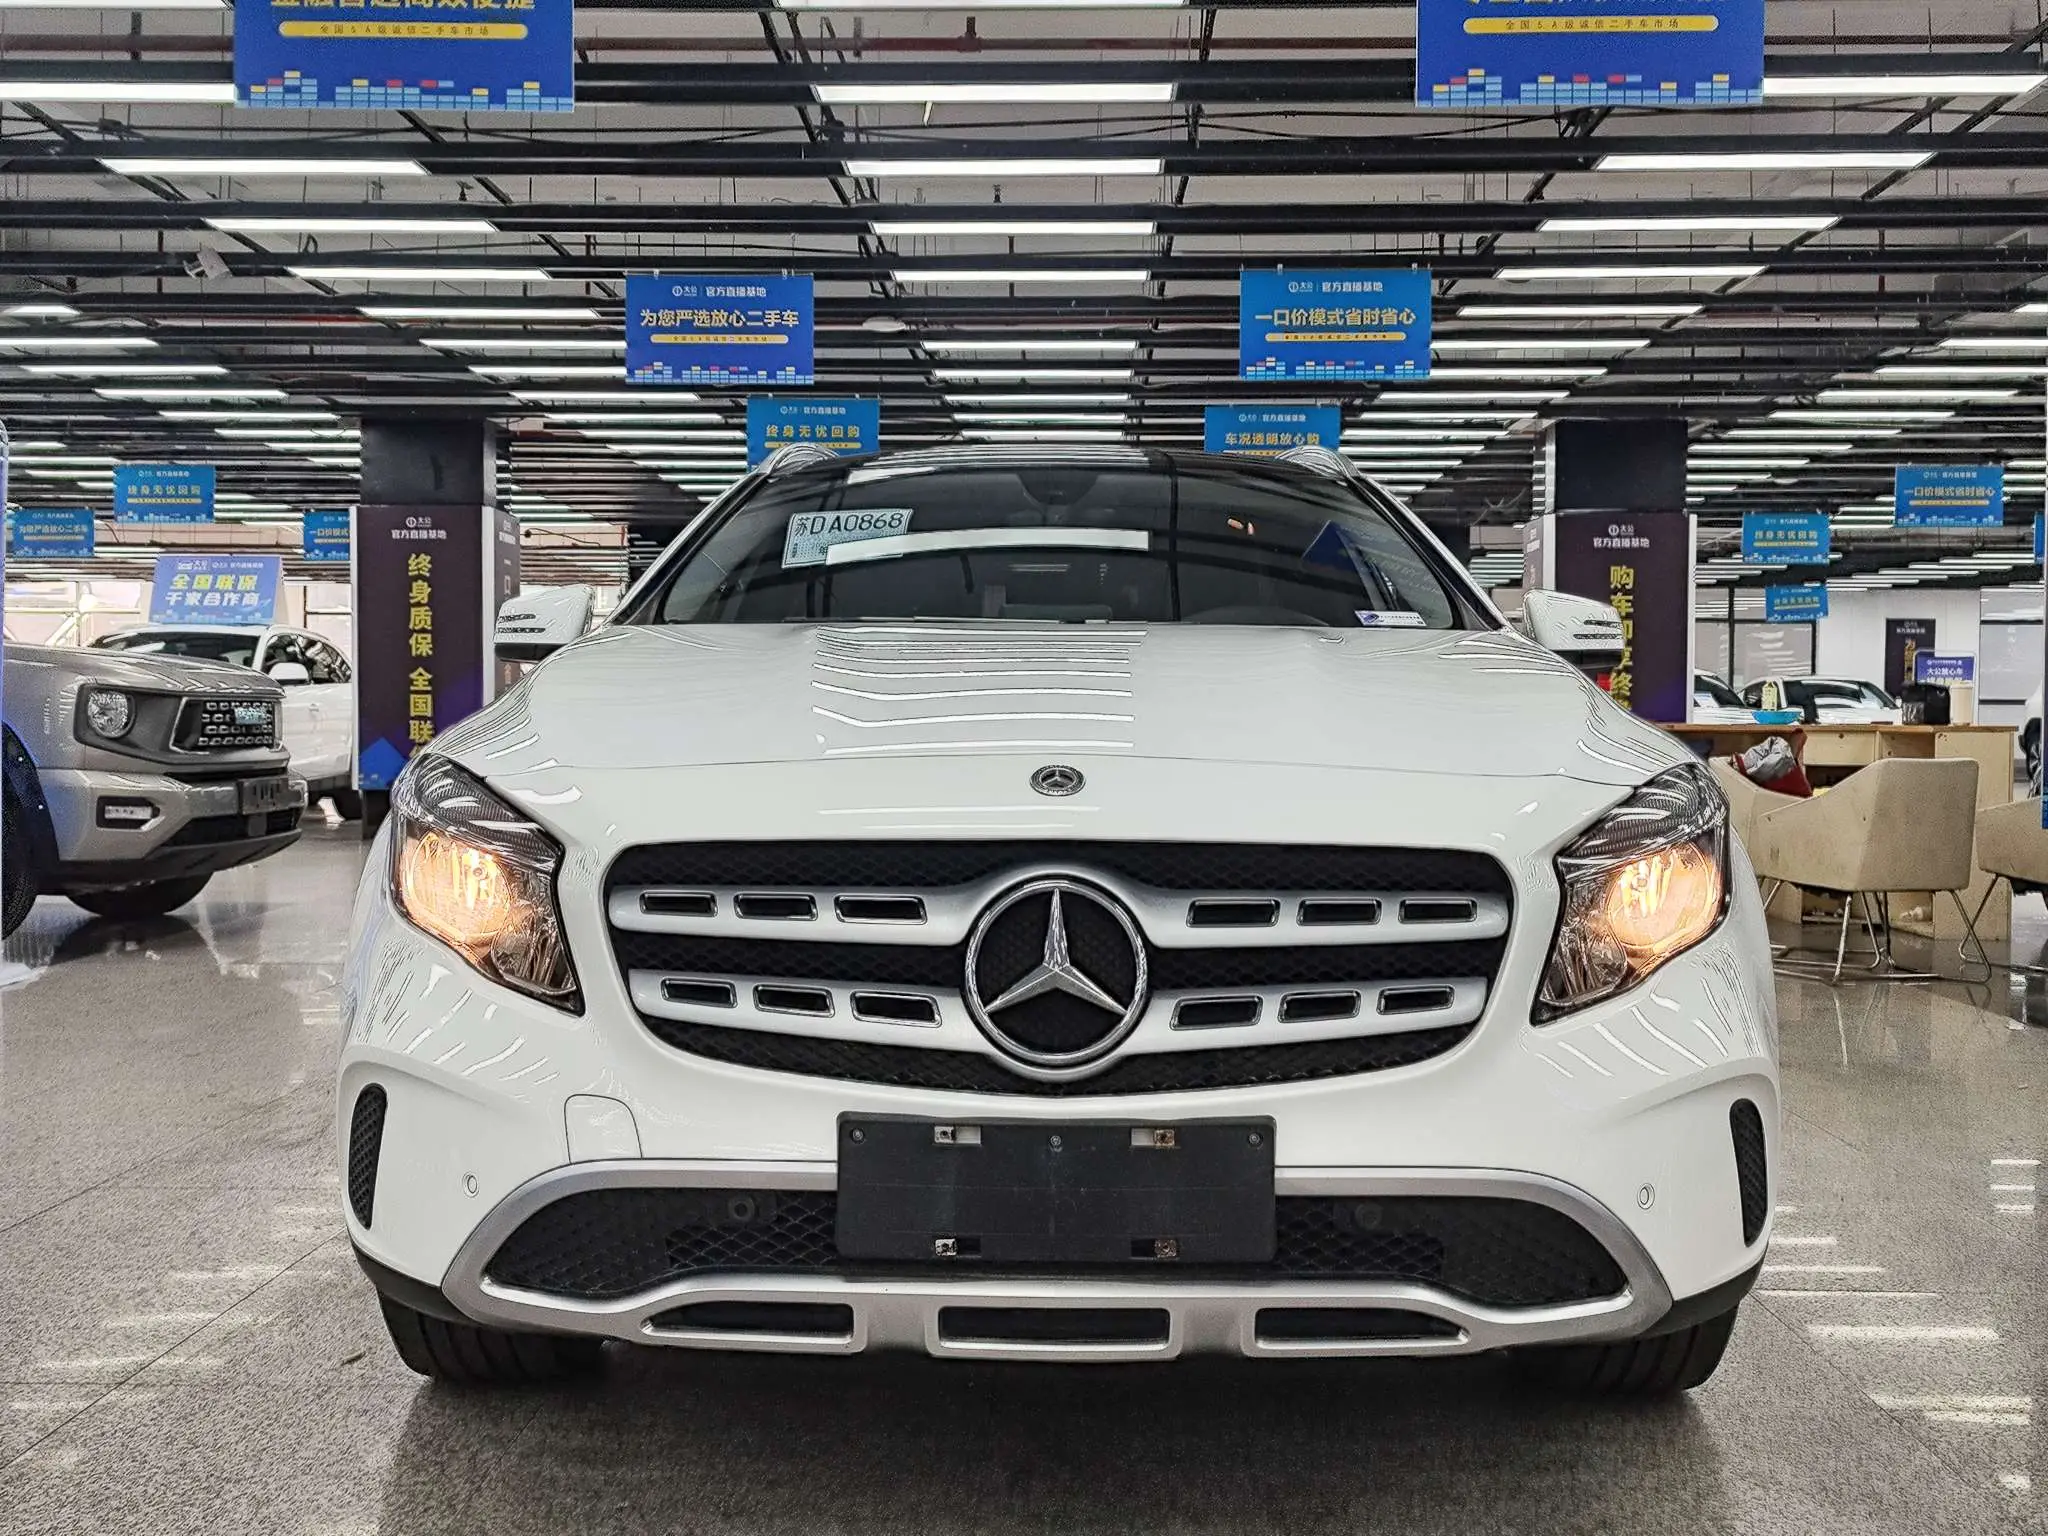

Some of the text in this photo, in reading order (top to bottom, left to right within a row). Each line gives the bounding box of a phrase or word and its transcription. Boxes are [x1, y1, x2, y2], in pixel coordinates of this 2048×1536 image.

[705, 286, 767, 297] 官方直播基地
[1321, 281, 1384, 293] 官方直播基地
[639, 308, 800, 327] 为您严选放心二手车
[1254, 307, 1417, 326] 一口价模式省时省心
[391, 529, 447, 540] 官方直播基地
[1593, 537, 1650, 548] 官方直播基地
[408, 553, 434, 759] 终身质保 全国联
